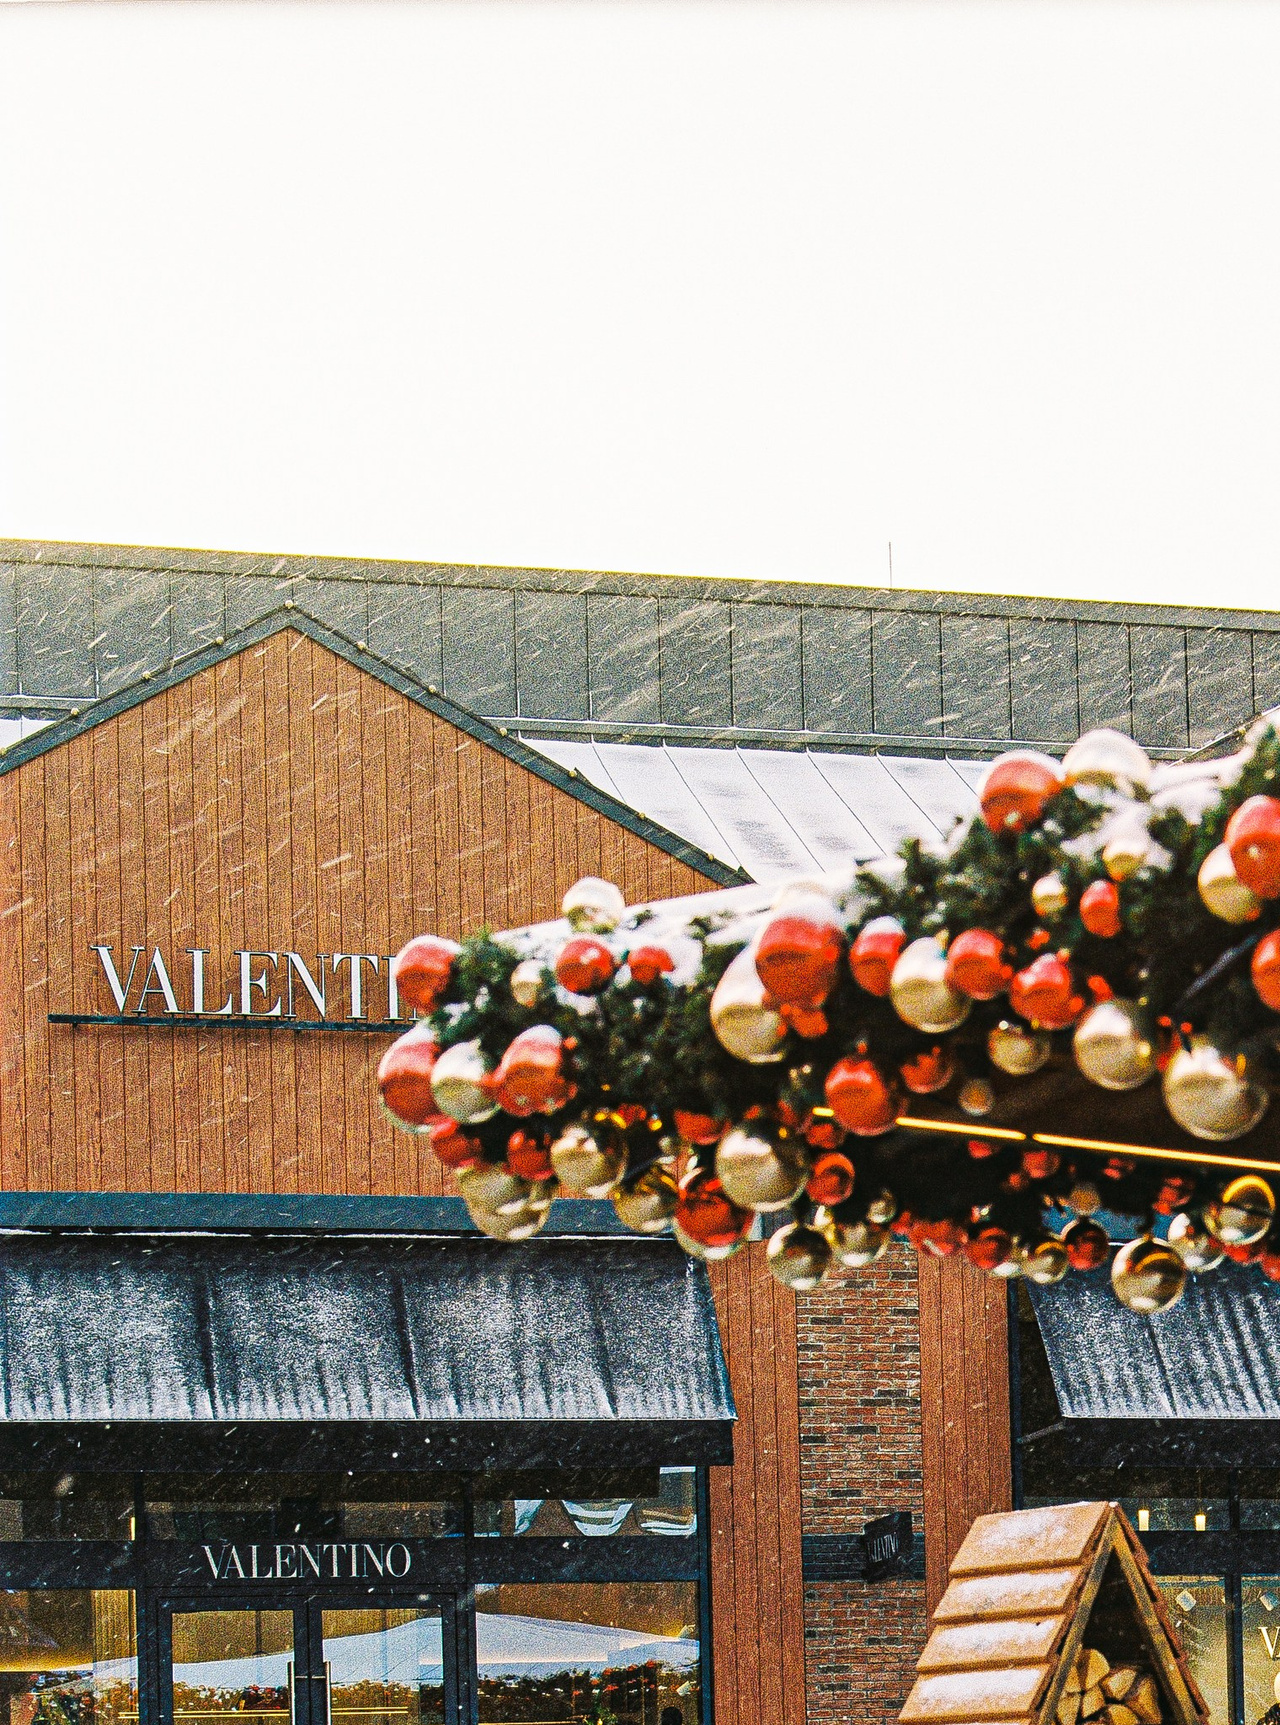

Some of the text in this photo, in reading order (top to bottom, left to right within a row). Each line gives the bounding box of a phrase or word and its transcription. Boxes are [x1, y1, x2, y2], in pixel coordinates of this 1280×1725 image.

[91, 945, 420, 1021] VALENTI
[201, 1542, 412, 1579] VALENTINO
[867, 1533, 899, 1563] VALENTIN
